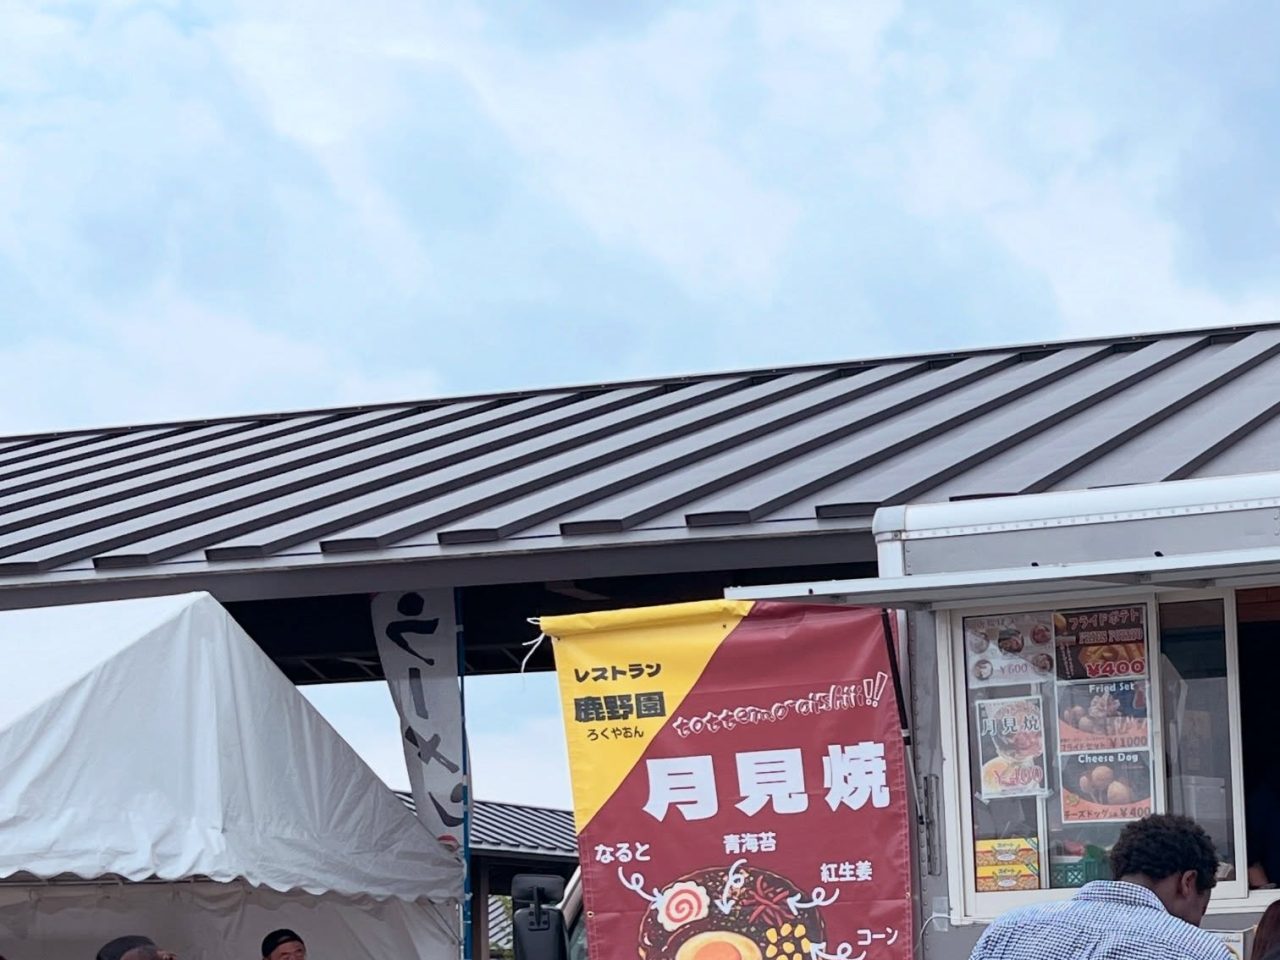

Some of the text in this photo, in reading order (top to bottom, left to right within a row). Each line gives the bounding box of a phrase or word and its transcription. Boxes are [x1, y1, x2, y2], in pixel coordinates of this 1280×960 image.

[574, 663, 662, 683] レストラン
[1085, 658, 1146, 677] ¥400
[1089, 682, 1135, 694] Fried Set
[574, 691, 666, 722] 鹿野園
[587, 726, 645, 741] ろくやおん
[982, 715, 1041, 737] 月見焼
[1078, 753, 1138, 764] Cheese Dog
[642, 741, 890, 823] 月見焼
[723, 831, 777, 853] 青海苔
[594, 842, 650, 863] なると
[820, 860, 873, 883] 紅生姜
[857, 927, 898, 946] コーン
